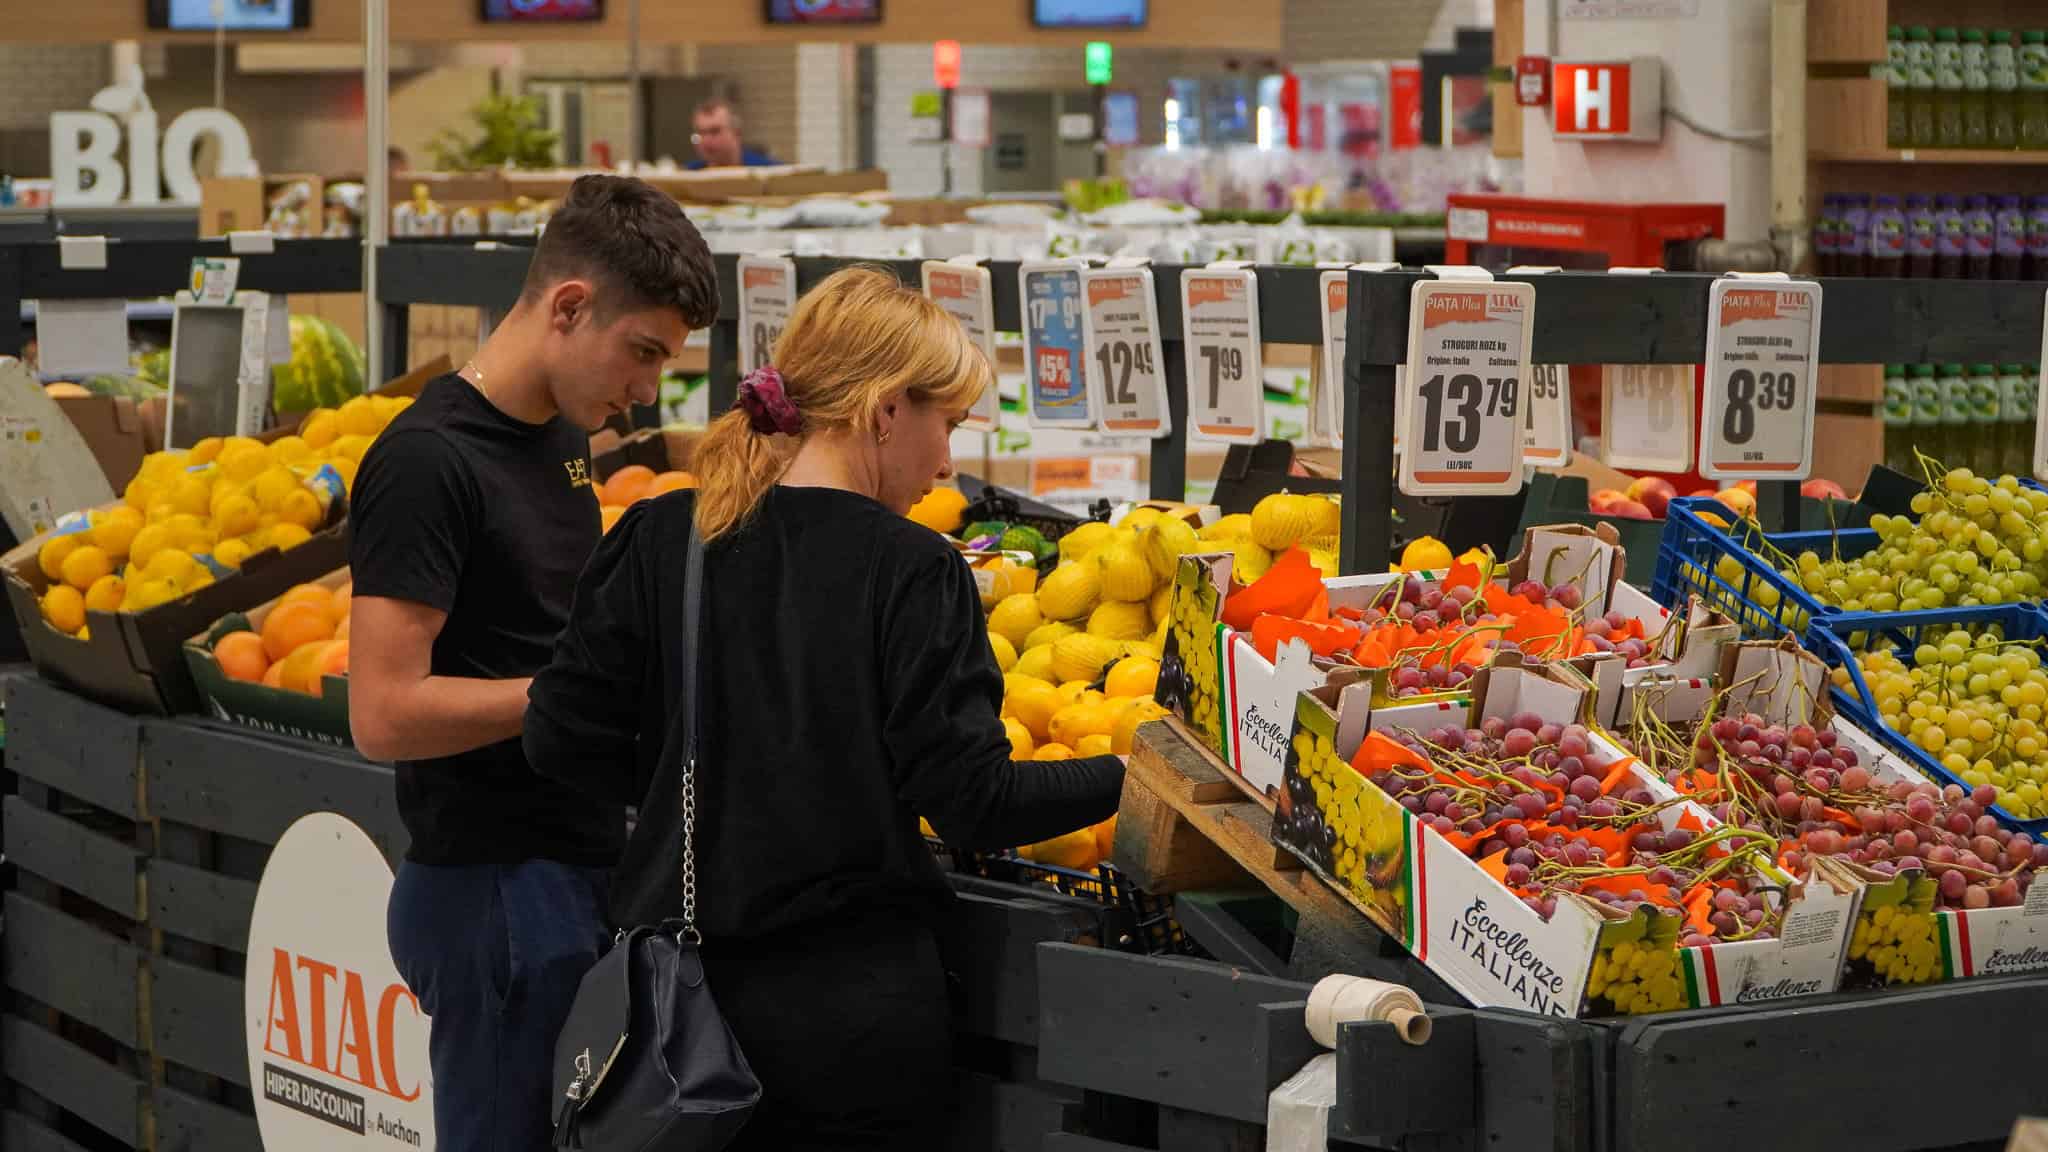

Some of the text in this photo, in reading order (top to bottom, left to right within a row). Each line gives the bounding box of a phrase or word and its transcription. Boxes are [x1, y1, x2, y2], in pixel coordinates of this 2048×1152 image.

[1575, 69, 1611, 129] H
[52, 107, 252, 209] BIO
[1039, 354, 1072, 386] 45%
[1096, 341, 1137, 405] 12
[1479, 339, 1497, 351] ROZE
[1200, 345, 1243, 409] 7 99
[1723, 368, 1796, 445] 8 39
[1419, 374, 1519, 453] 13 79
[1240, 718, 1282, 763] ITALIA
[1464, 895, 1564, 994] Eccellenze
[1736, 978, 1823, 1005] Eccellenze
[263, 946, 421, 1103] ATAC
[266, 1070, 363, 1127] HIPER DISCOUNT
[376, 1112, 421, 1148] Auchan
